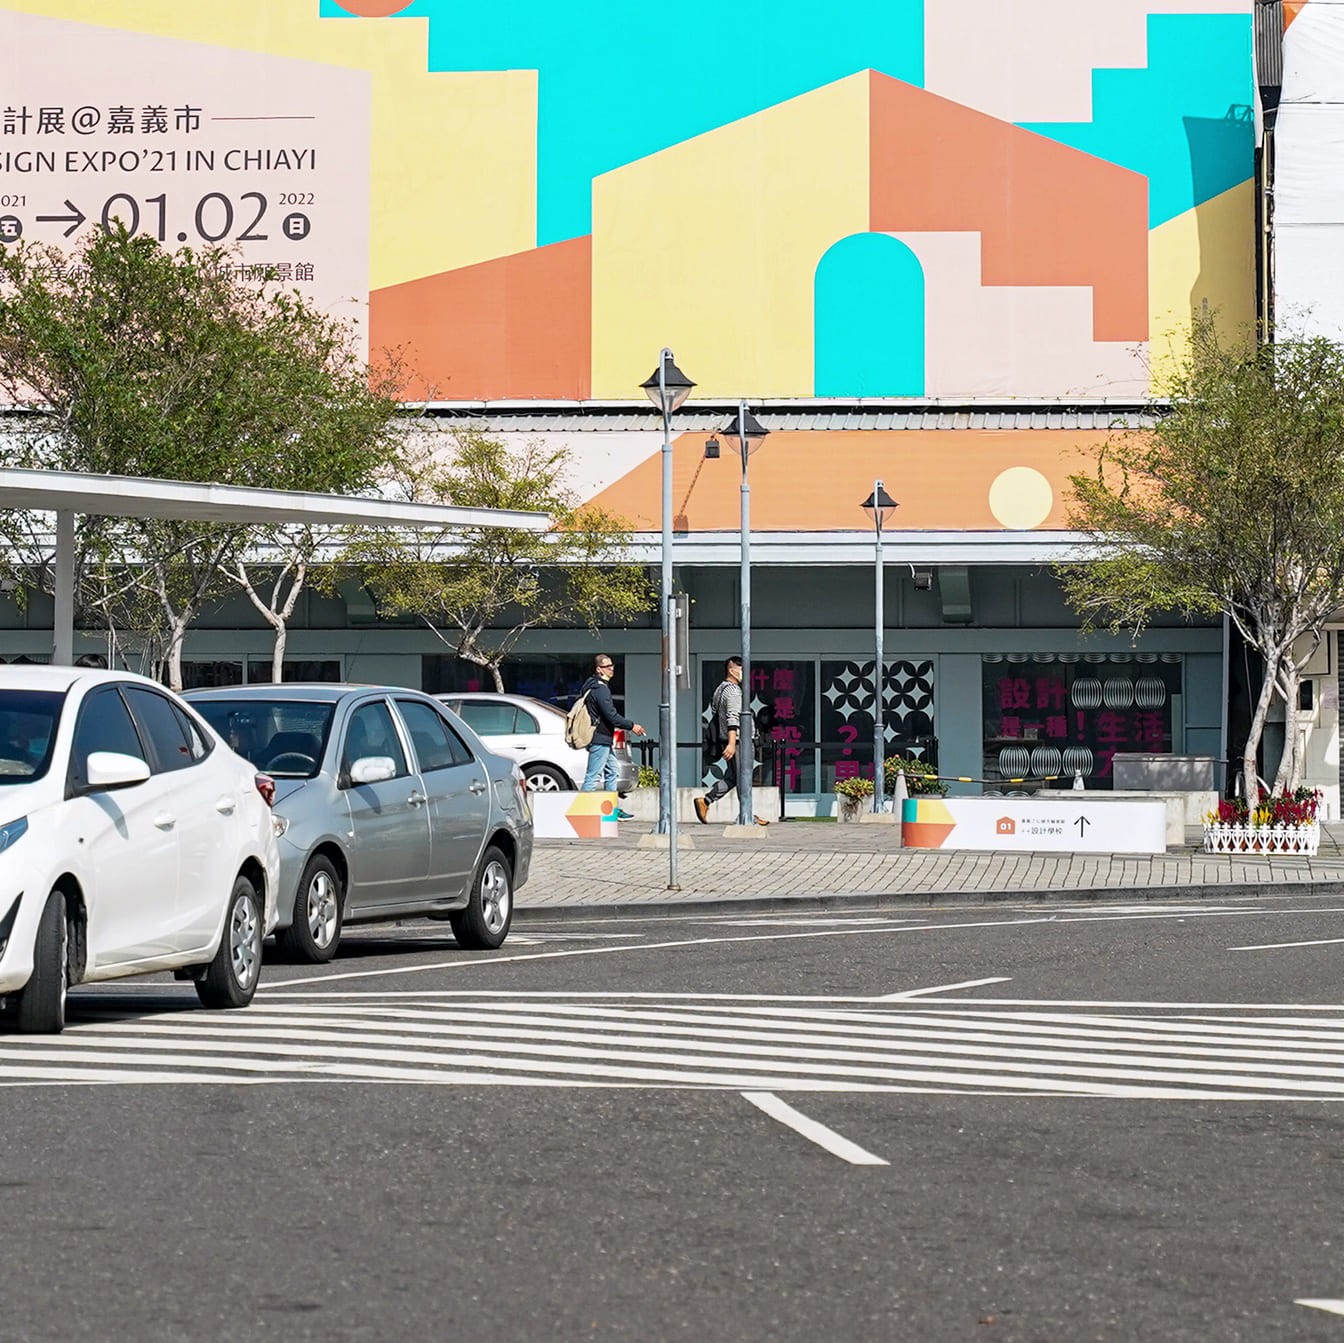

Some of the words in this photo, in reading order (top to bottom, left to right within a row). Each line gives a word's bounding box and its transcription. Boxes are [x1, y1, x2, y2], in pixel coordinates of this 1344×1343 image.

[186, 150, 214, 171] IN
[224, 149, 316, 171] CHIAYI
[101, 191, 270, 243] 01.02
[1000, 822, 1011, 830] 01
